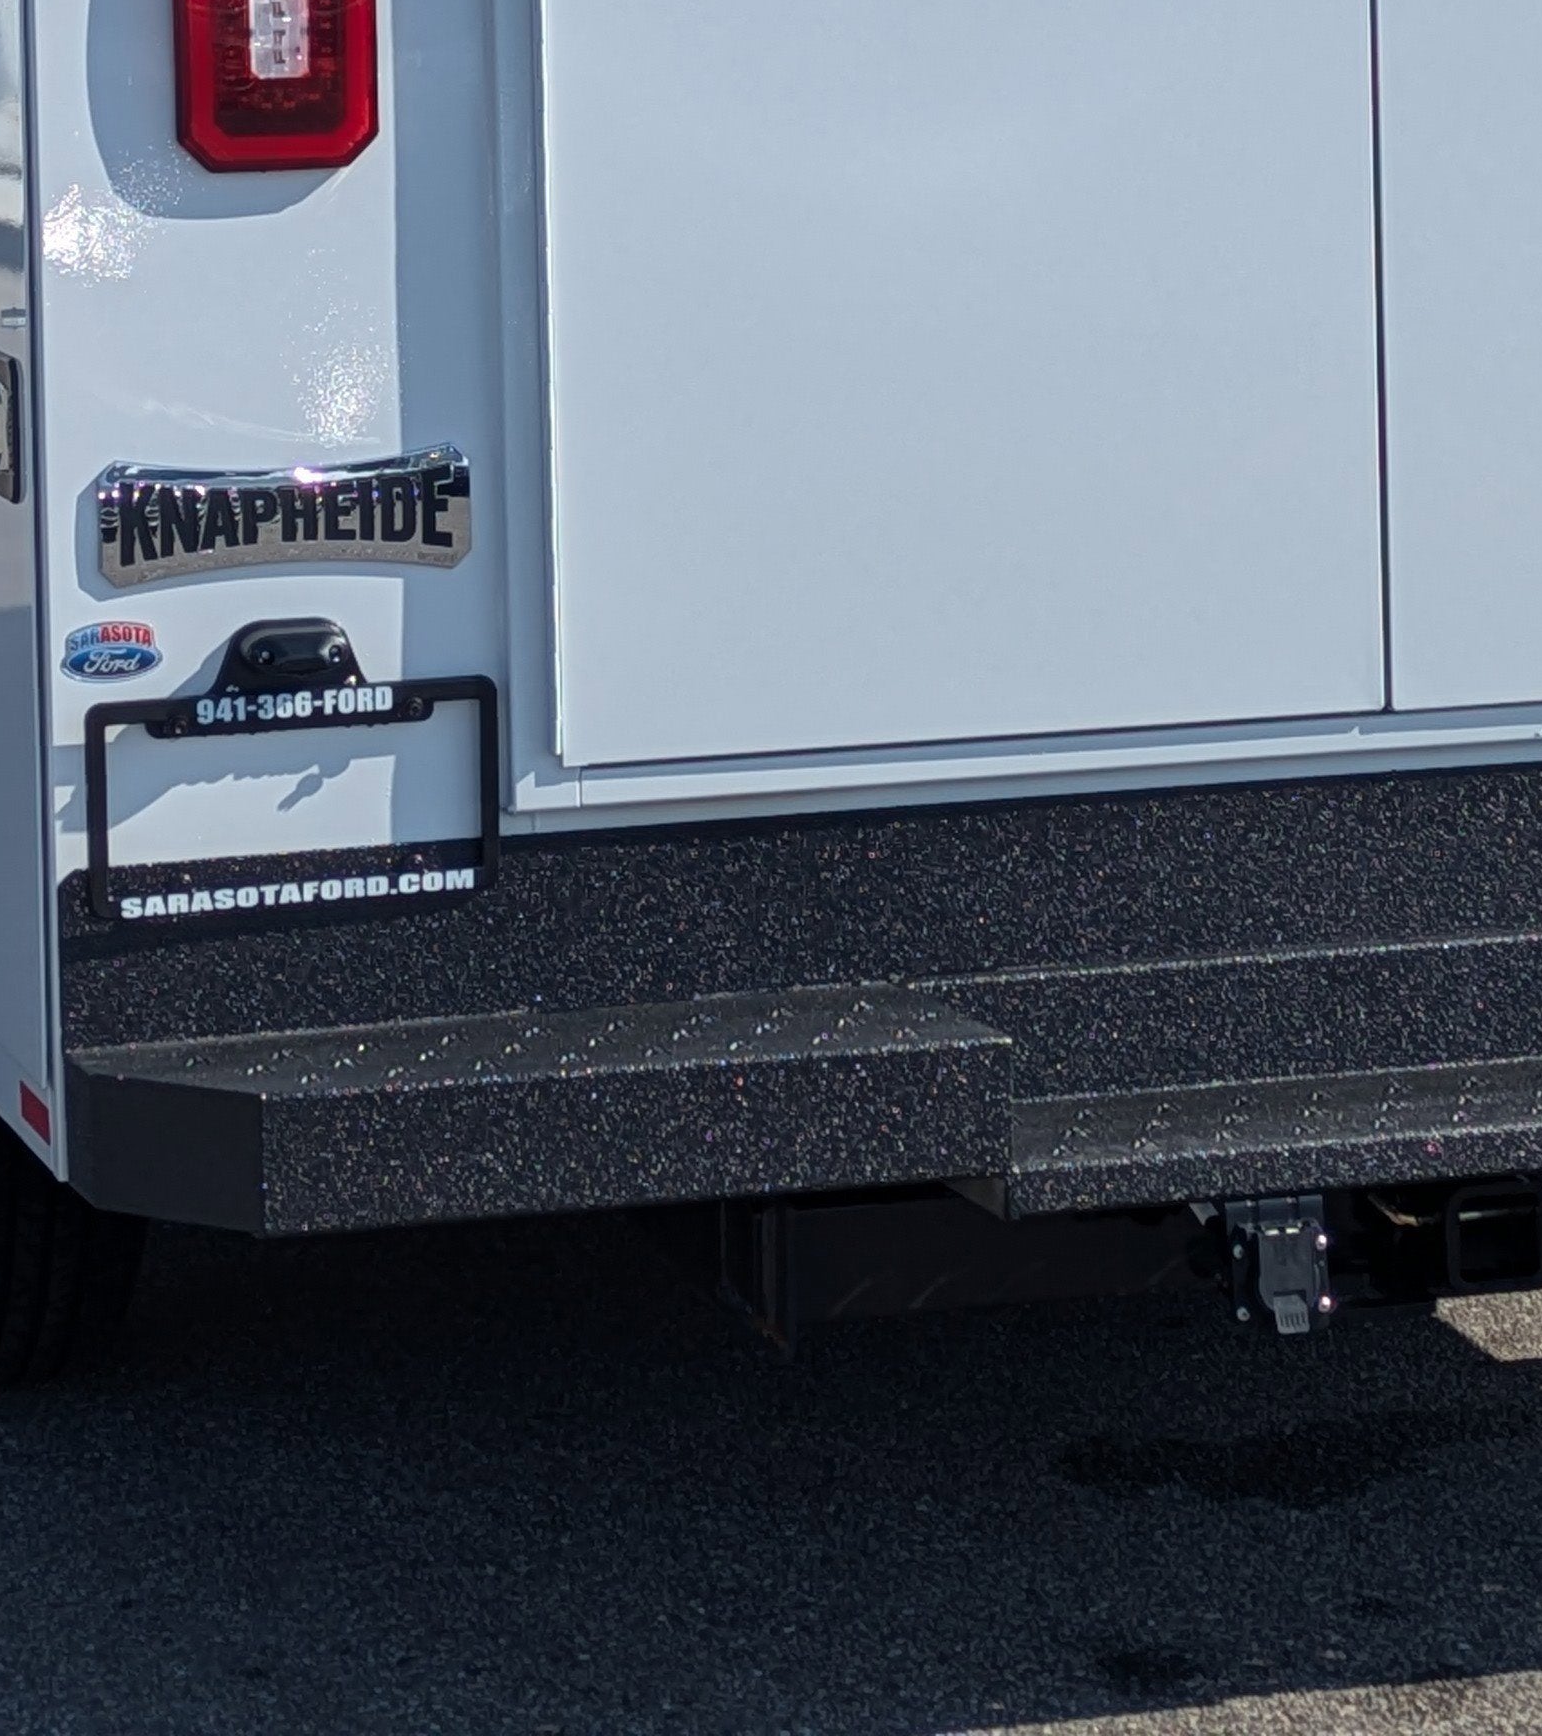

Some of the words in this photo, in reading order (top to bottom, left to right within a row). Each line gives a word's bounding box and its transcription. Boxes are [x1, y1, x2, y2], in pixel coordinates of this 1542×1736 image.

[119, 464, 455, 567] KNAPHEIDE
[70, 625, 153, 651] SARASOTA
[83, 648, 141, 674] Ford
[196, 686, 393, 725] 941-366-FORD
[120, 868, 475, 920] SARASOTAFORD.COM
